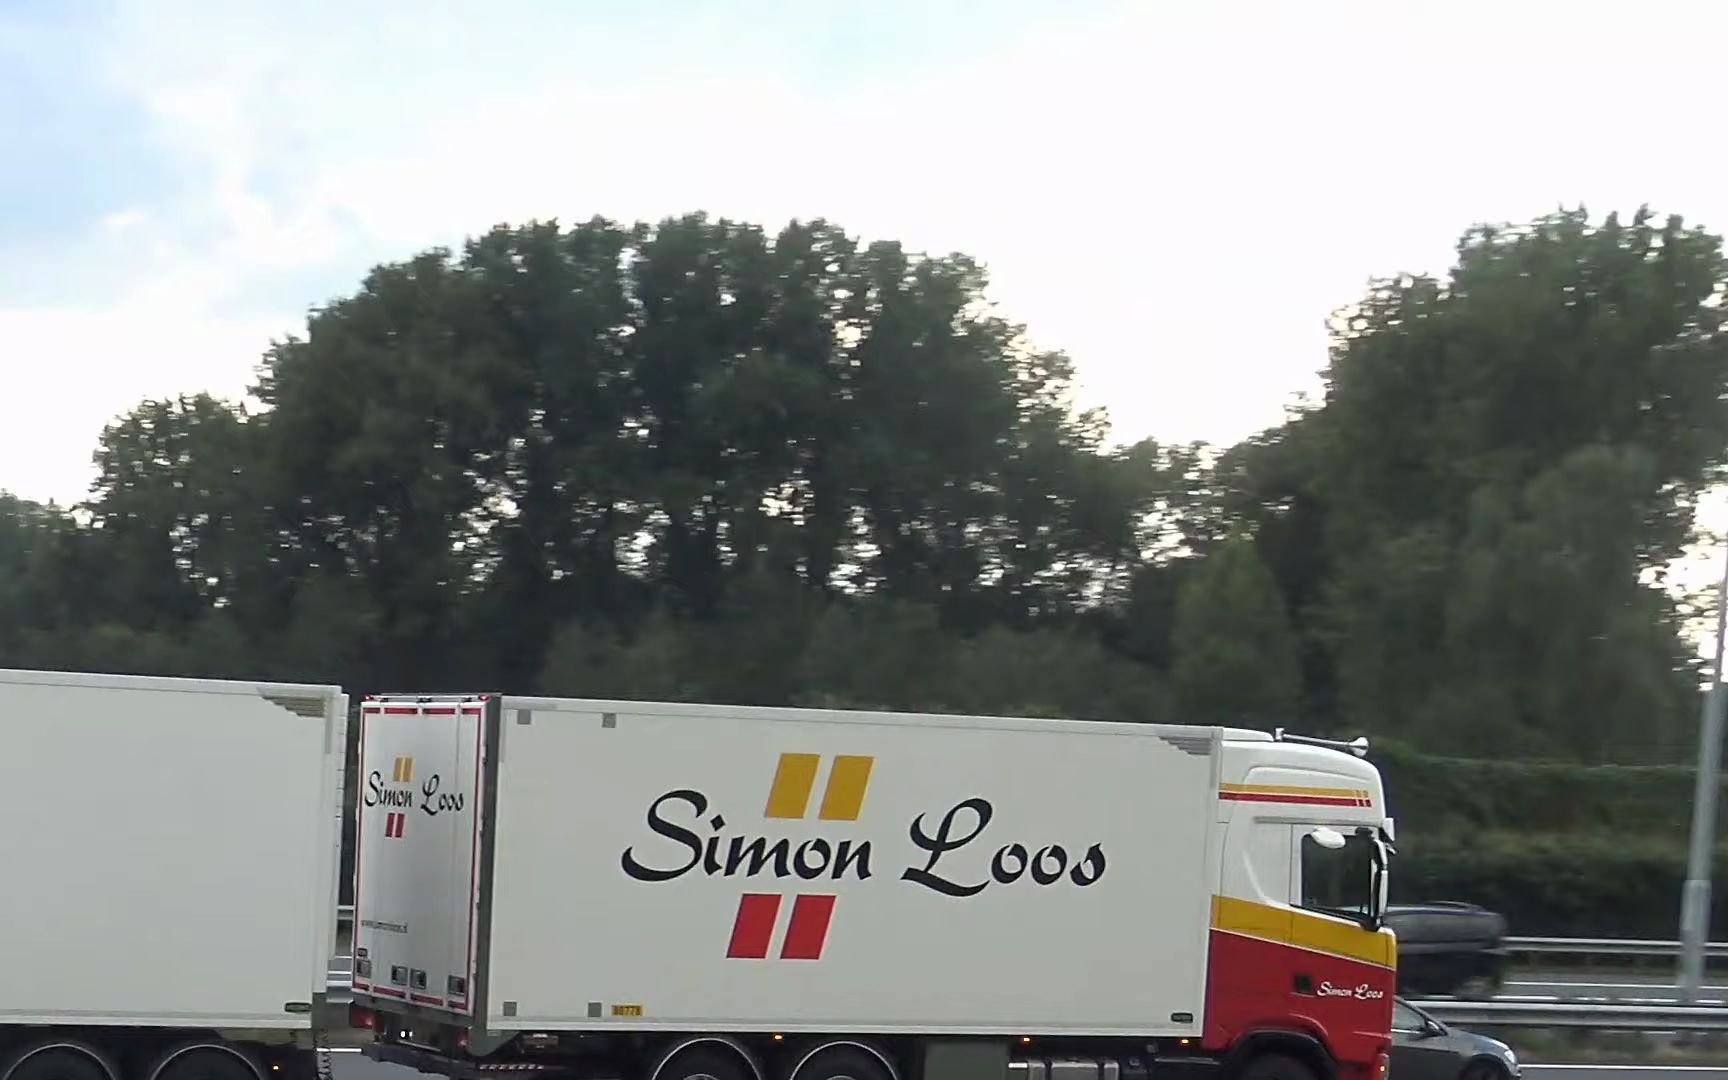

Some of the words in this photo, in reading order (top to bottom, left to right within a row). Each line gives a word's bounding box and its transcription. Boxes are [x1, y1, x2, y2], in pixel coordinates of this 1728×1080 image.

[365, 770, 413, 808] Simon
[420, 773, 464, 816] Loos
[621, 789, 872, 882] Simon
[900, 797, 1106, 897] Loos
[1316, 981, 1353, 997] Simon
[1354, 983, 1384, 1000] Loos
